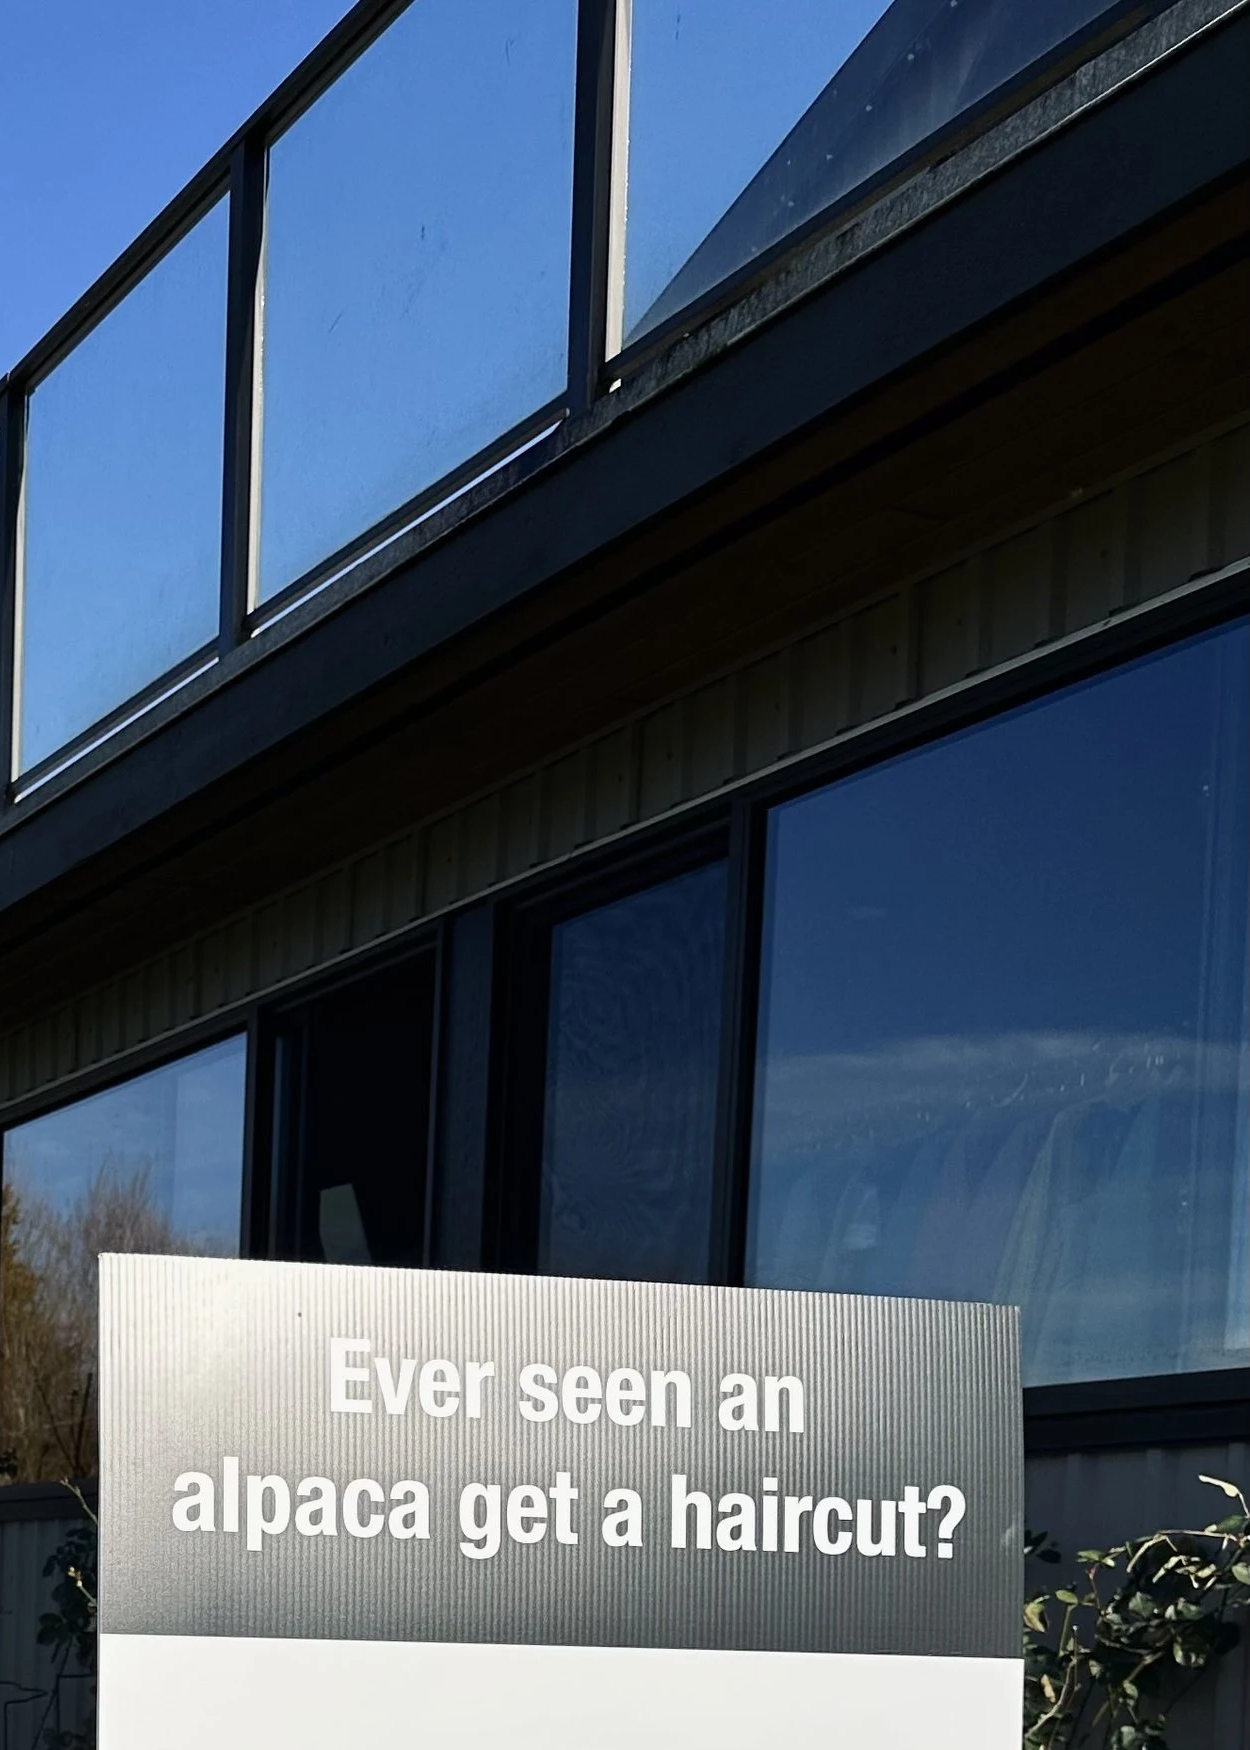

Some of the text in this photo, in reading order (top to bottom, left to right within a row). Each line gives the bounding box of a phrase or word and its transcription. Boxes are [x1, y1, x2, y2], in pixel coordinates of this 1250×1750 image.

[329, 1337, 806, 1434] Ever seen an
[172, 1457, 966, 1559] alpaca get a haircut?
